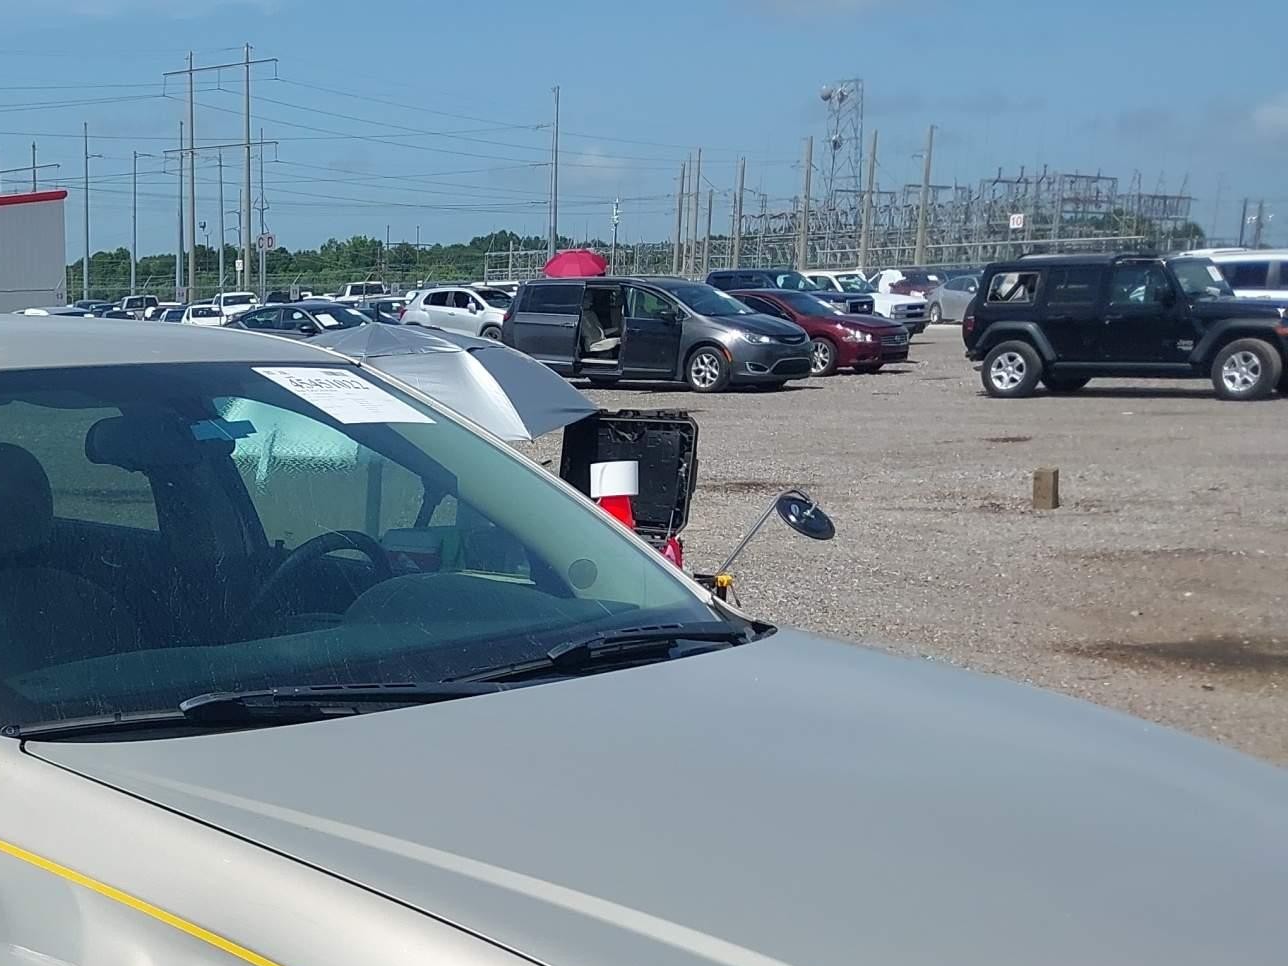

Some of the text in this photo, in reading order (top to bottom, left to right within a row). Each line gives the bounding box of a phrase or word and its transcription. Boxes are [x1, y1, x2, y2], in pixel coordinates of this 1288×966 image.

[1012, 215, 1022, 226] 10
[258, 236, 274, 249] C D
